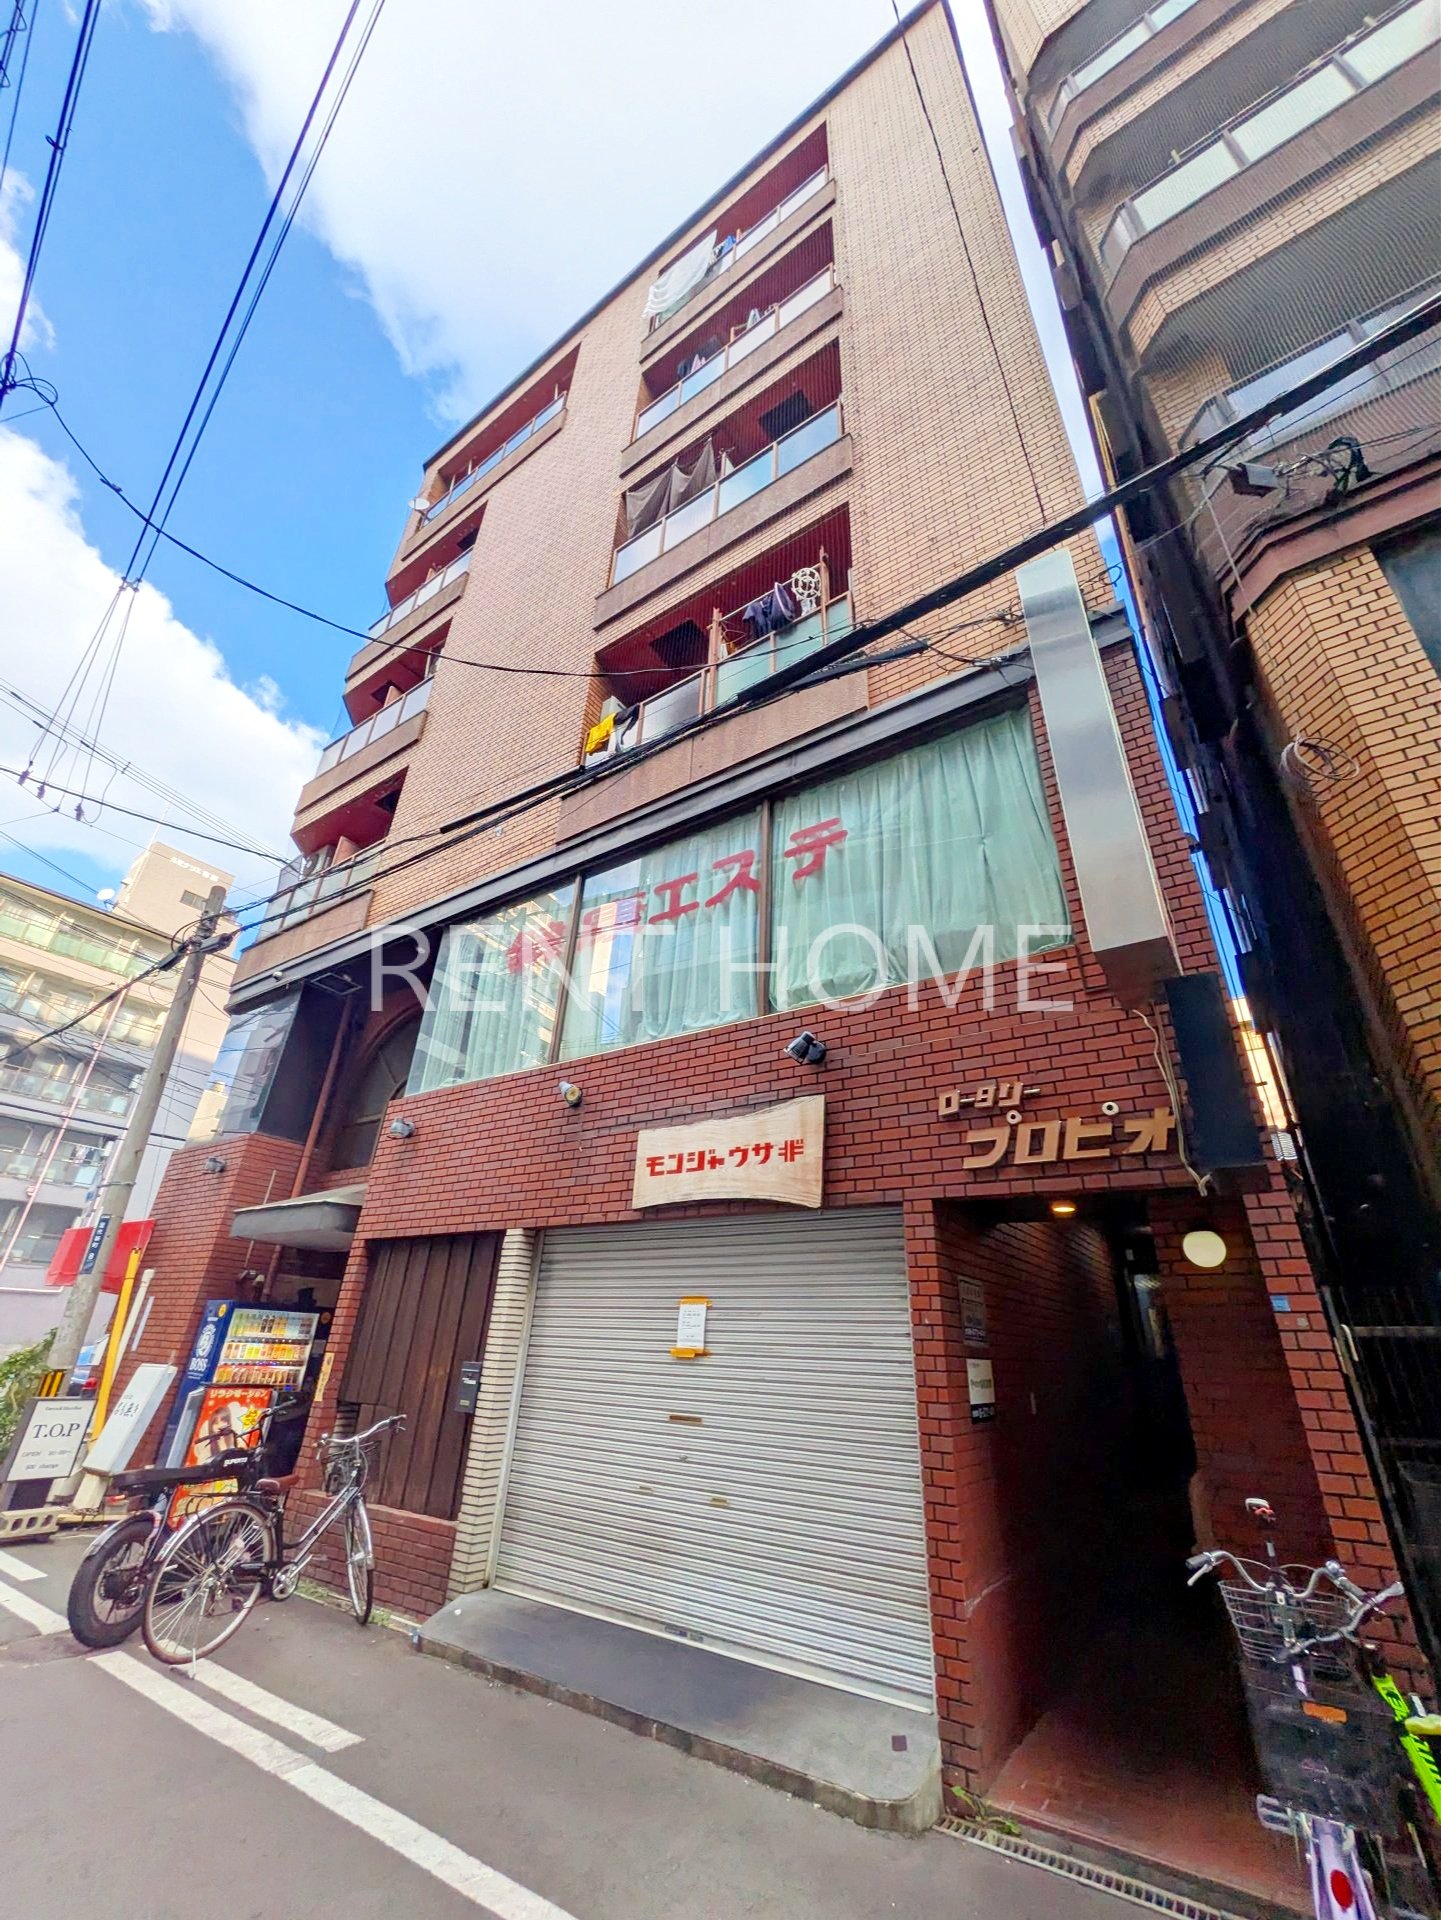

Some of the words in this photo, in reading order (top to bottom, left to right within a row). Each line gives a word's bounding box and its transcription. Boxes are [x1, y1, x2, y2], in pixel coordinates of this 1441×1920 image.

[938, 1081, 1041, 1118] ロータリー
[962, 1101, 1176, 1169] プロピオ
[645, 1138, 805, 1177] モンジャウサギ
[189, 1358, 208, 1371] BOSS
[33, 1423, 80, 1438] T.O.P
